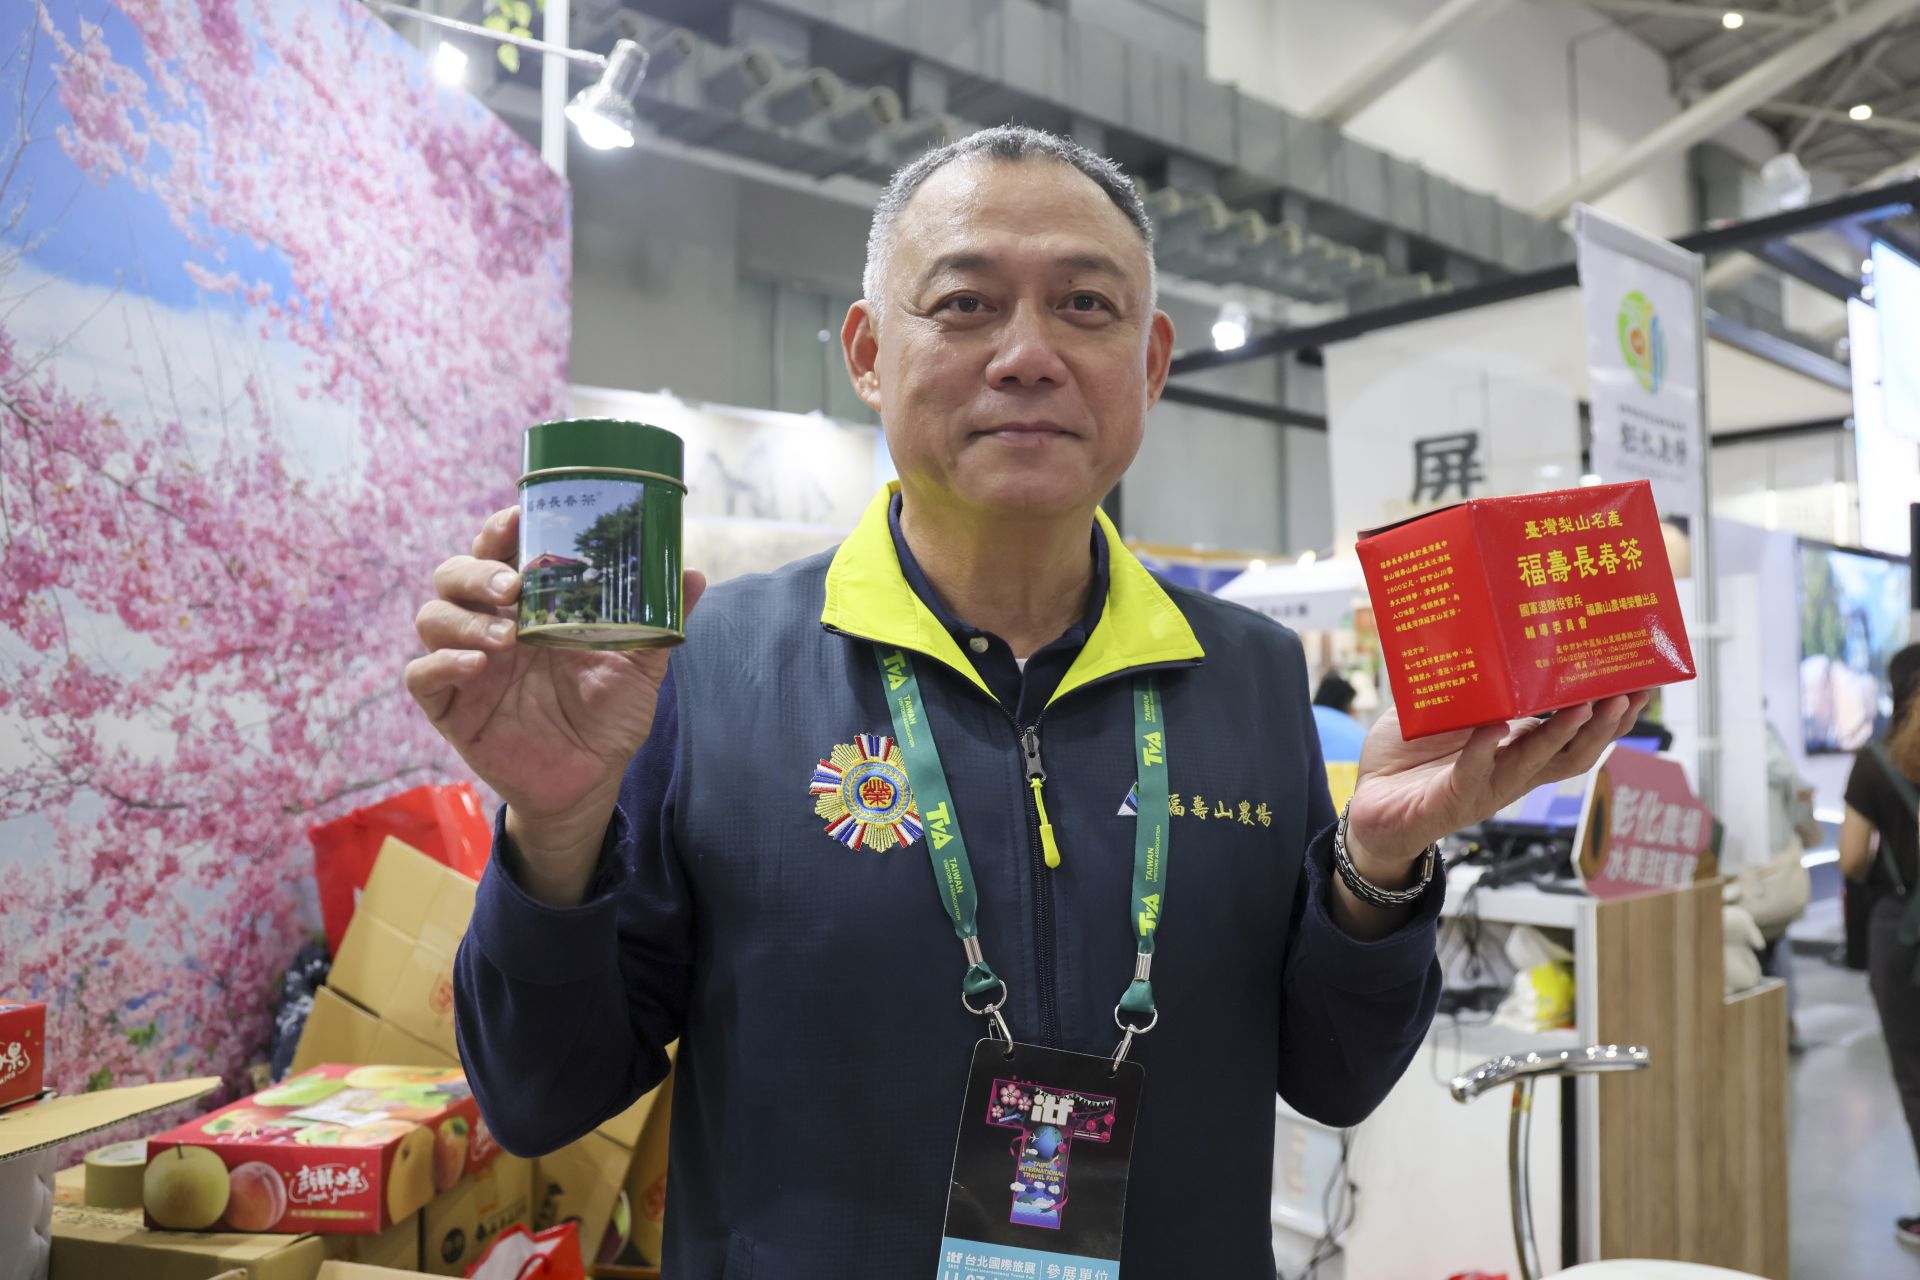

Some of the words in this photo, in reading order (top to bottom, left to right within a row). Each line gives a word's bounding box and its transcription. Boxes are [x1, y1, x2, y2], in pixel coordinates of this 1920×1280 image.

[1412, 432, 1483, 505] 屏
[1525, 510, 1623, 540] 臺灣梨山名產
[1517, 538, 1643, 588] 福壽長春茶
[1519, 594, 1583, 617] 國軍退除役官兵
[904, 694, 917, 725] TAIWAN
[863, 779, 892, 806] 榮
[949, 857, 964, 894] TAIWAN
[1145, 847, 1155, 881] TAIWAN
[1031, 1094, 1075, 1126] itf
[1018, 1165, 1065, 1178] INTERNATIONAL
[1022, 1172, 1046, 1181] TRAVEL
[1046, 1175, 1060, 1183] FAIR
[965, 1253, 1037, 1275] 台北國際旅展
[1046, 1263, 1109, 1280] 參展單位
